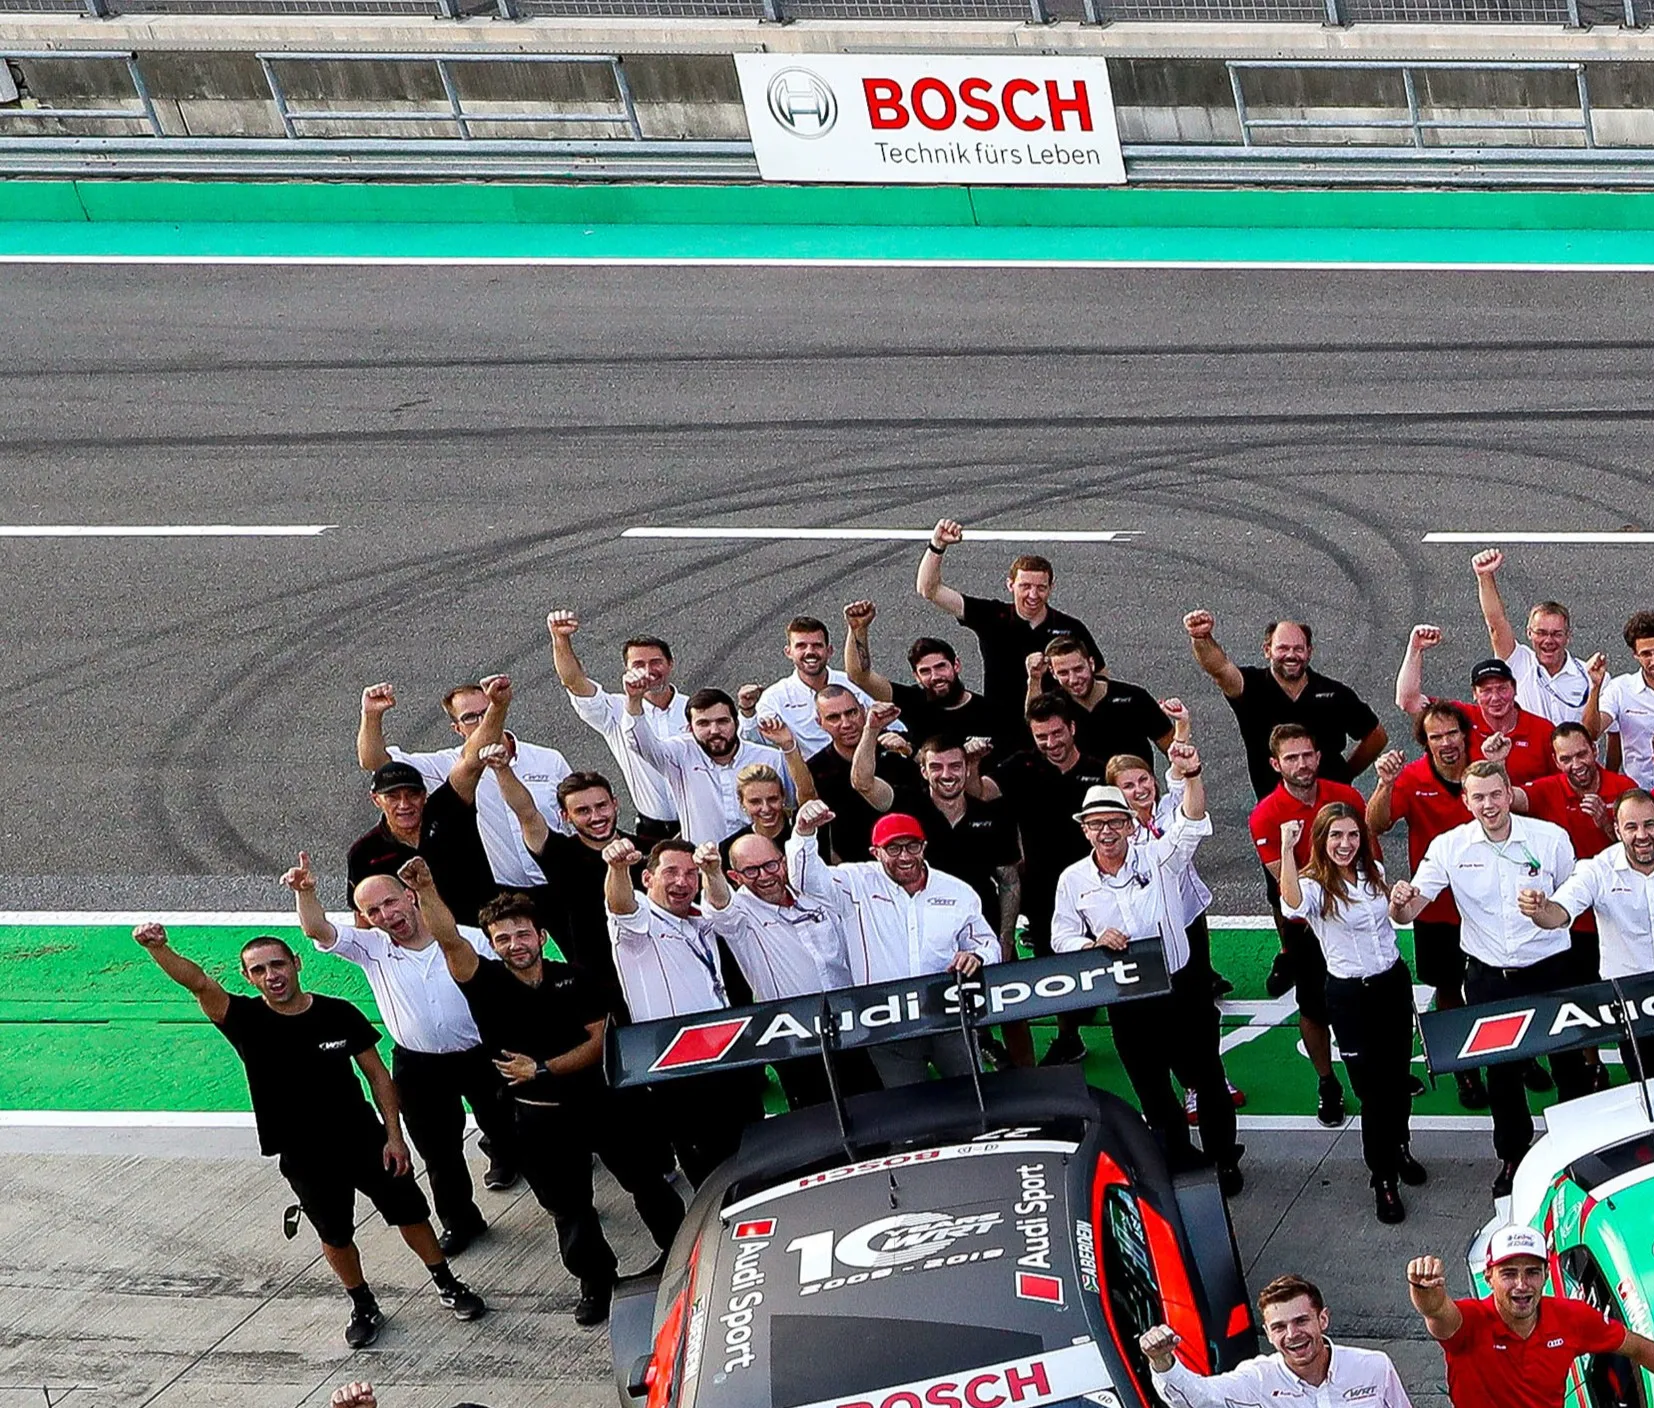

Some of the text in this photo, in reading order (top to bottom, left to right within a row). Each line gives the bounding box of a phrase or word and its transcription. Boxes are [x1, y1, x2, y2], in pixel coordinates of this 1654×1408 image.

[862, 77, 1094, 132] BOSCH
[875, 141, 1101, 165] Technik fürs Leben
[755, 959, 1140, 1047] Audi Sport
[799, 1150, 940, 1187] BOSCH
[1014, 1164, 1055, 1269] Audi Sport
[719, 1241, 770, 1373] Audi Sport
